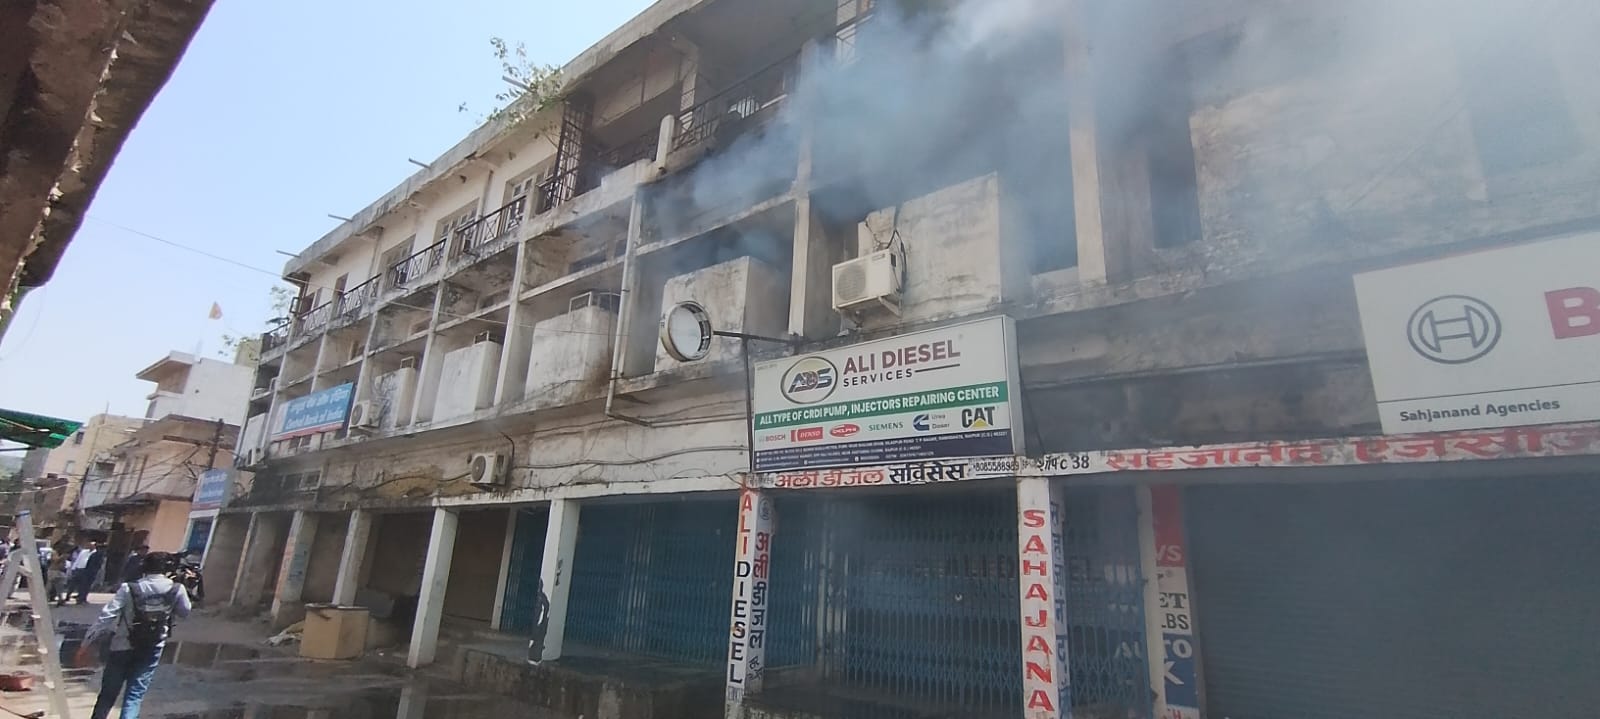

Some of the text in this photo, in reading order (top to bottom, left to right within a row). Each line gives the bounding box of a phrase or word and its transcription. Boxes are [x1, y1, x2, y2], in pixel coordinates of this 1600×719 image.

[843, 340, 961, 375] ALI DIESEL
[843, 368, 913, 387] SERVICES
[760, 386, 999, 425] ALL TYPE OF CRDI PUMP, INJECTORS REPAIRING CENTER
[1400, 399, 1560, 422] Sahjanand Agencies
[868, 421, 904, 432] SIEMENS
[962, 406, 995, 428] CAT
[1071, 455, 1089, 469] 38
[774, 470, 819, 488] अली
[729, 560, 751, 684] DIESEL
